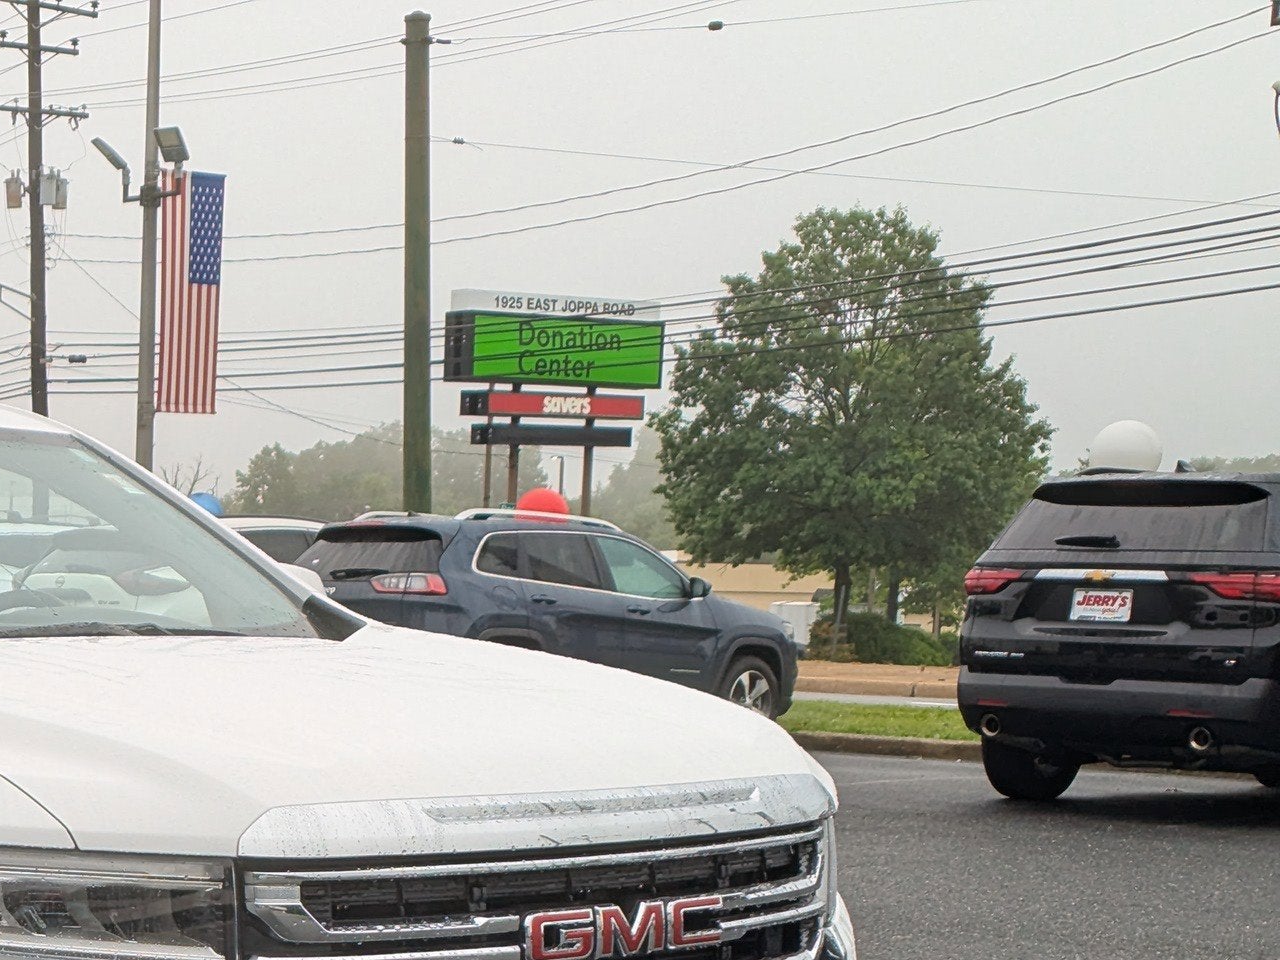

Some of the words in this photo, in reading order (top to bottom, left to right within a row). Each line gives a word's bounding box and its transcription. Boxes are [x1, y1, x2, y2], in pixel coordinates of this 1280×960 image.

[494, 295, 523, 309] 1925
[526, 297, 558, 312] EAST
[561, 299, 599, 314] JOPPA
[602, 302, 636, 316] ROAD
[519, 321, 621, 351] Donation
[518, 349, 596, 378] Center
[1076, 594, 1129, 608] JERRY'S
